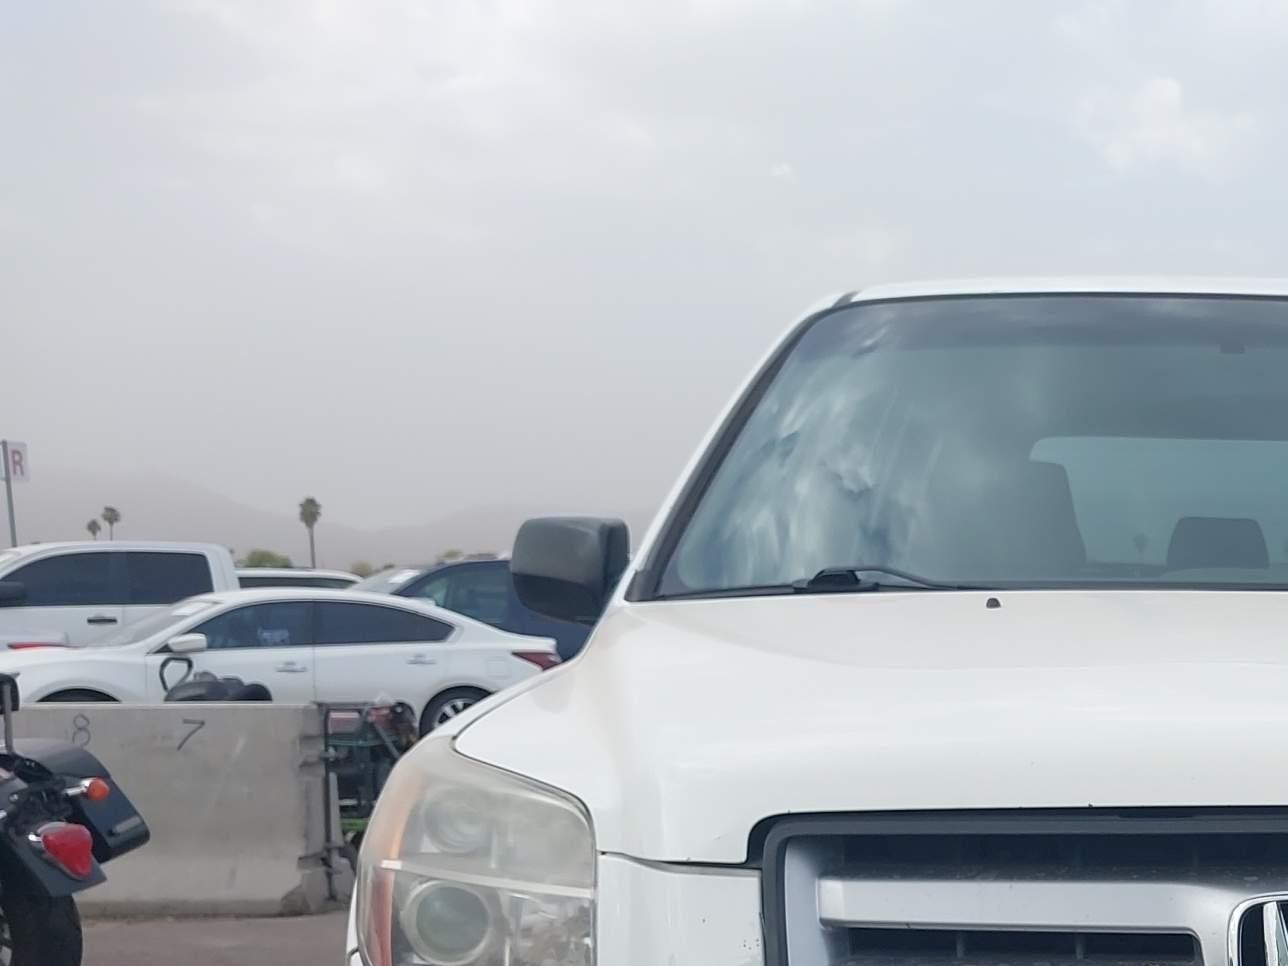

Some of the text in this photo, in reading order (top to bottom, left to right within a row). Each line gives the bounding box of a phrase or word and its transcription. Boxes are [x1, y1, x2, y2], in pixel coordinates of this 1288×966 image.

[10, 449, 25, 477] R
[71, 713, 91, 751] 8
[176, 718, 206, 751] 7
